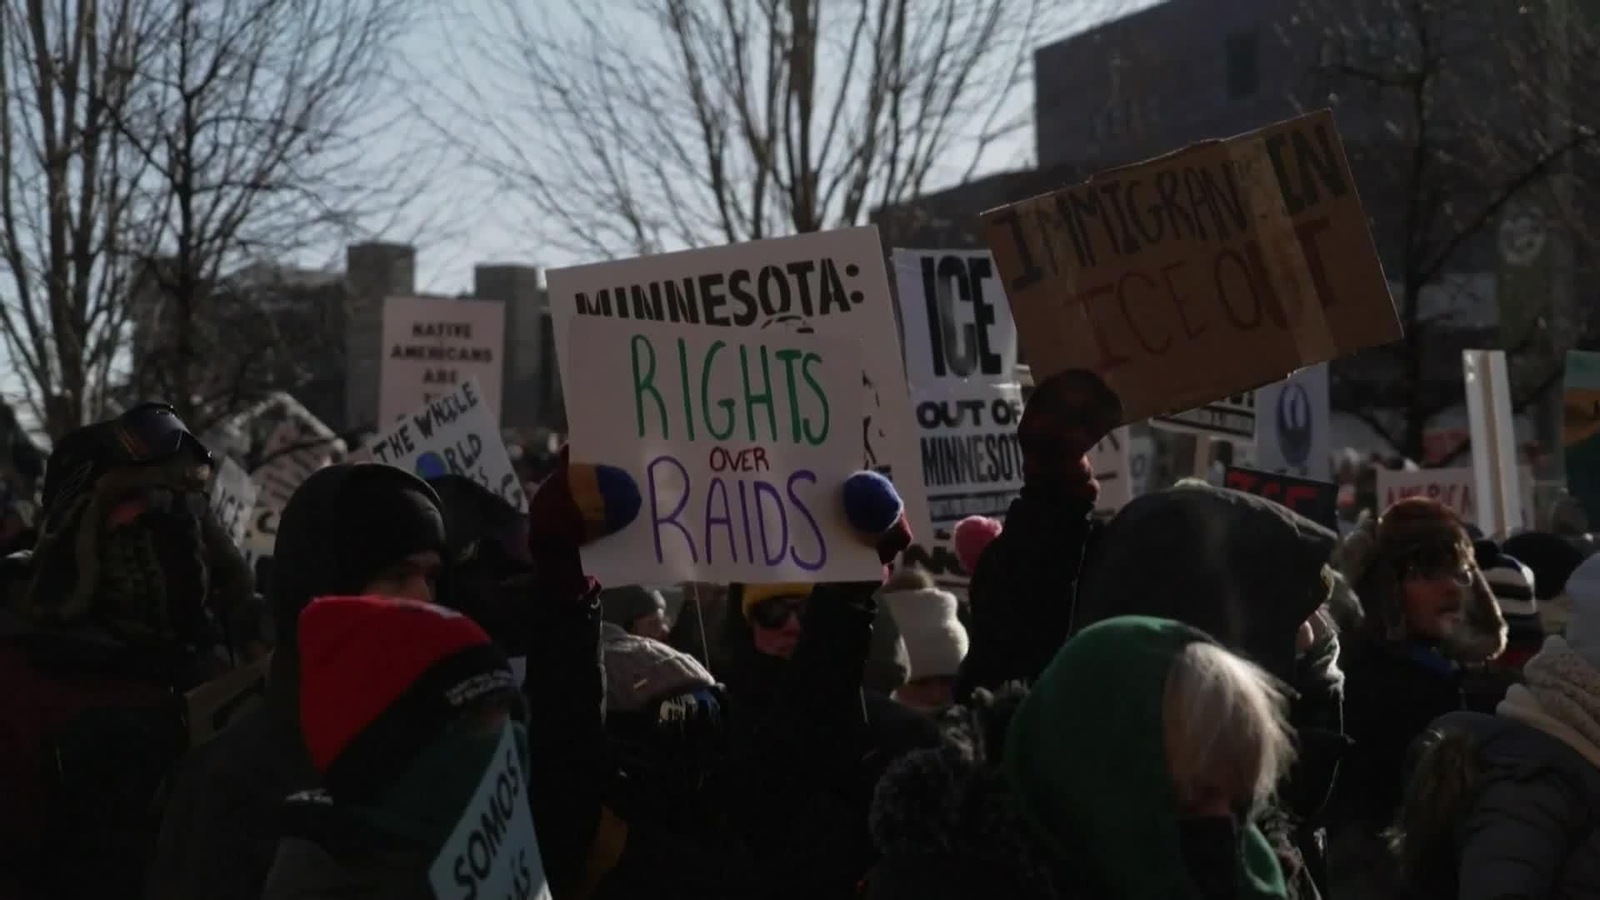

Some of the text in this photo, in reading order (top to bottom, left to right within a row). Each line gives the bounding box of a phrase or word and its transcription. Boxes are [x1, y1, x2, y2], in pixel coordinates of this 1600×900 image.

[575, 258, 864, 327] MINNESOTA:
[920, 256, 1001, 377] ICE
[1065, 261, 1207, 373] ICE
[390, 344, 493, 363] AMERICANS
[412, 321, 472, 338] NATIVE
[422, 369, 457, 384] ARE
[631, 334, 829, 445] RIGHTS
[917, 401, 985, 429] OUT
[373, 424, 415, 464] THE
[709, 446, 769, 472] OVER
[920, 433, 1022, 486] MINNESOT
[647, 455, 827, 571] RAIDS
[454, 746, 519, 900] SOMOS
